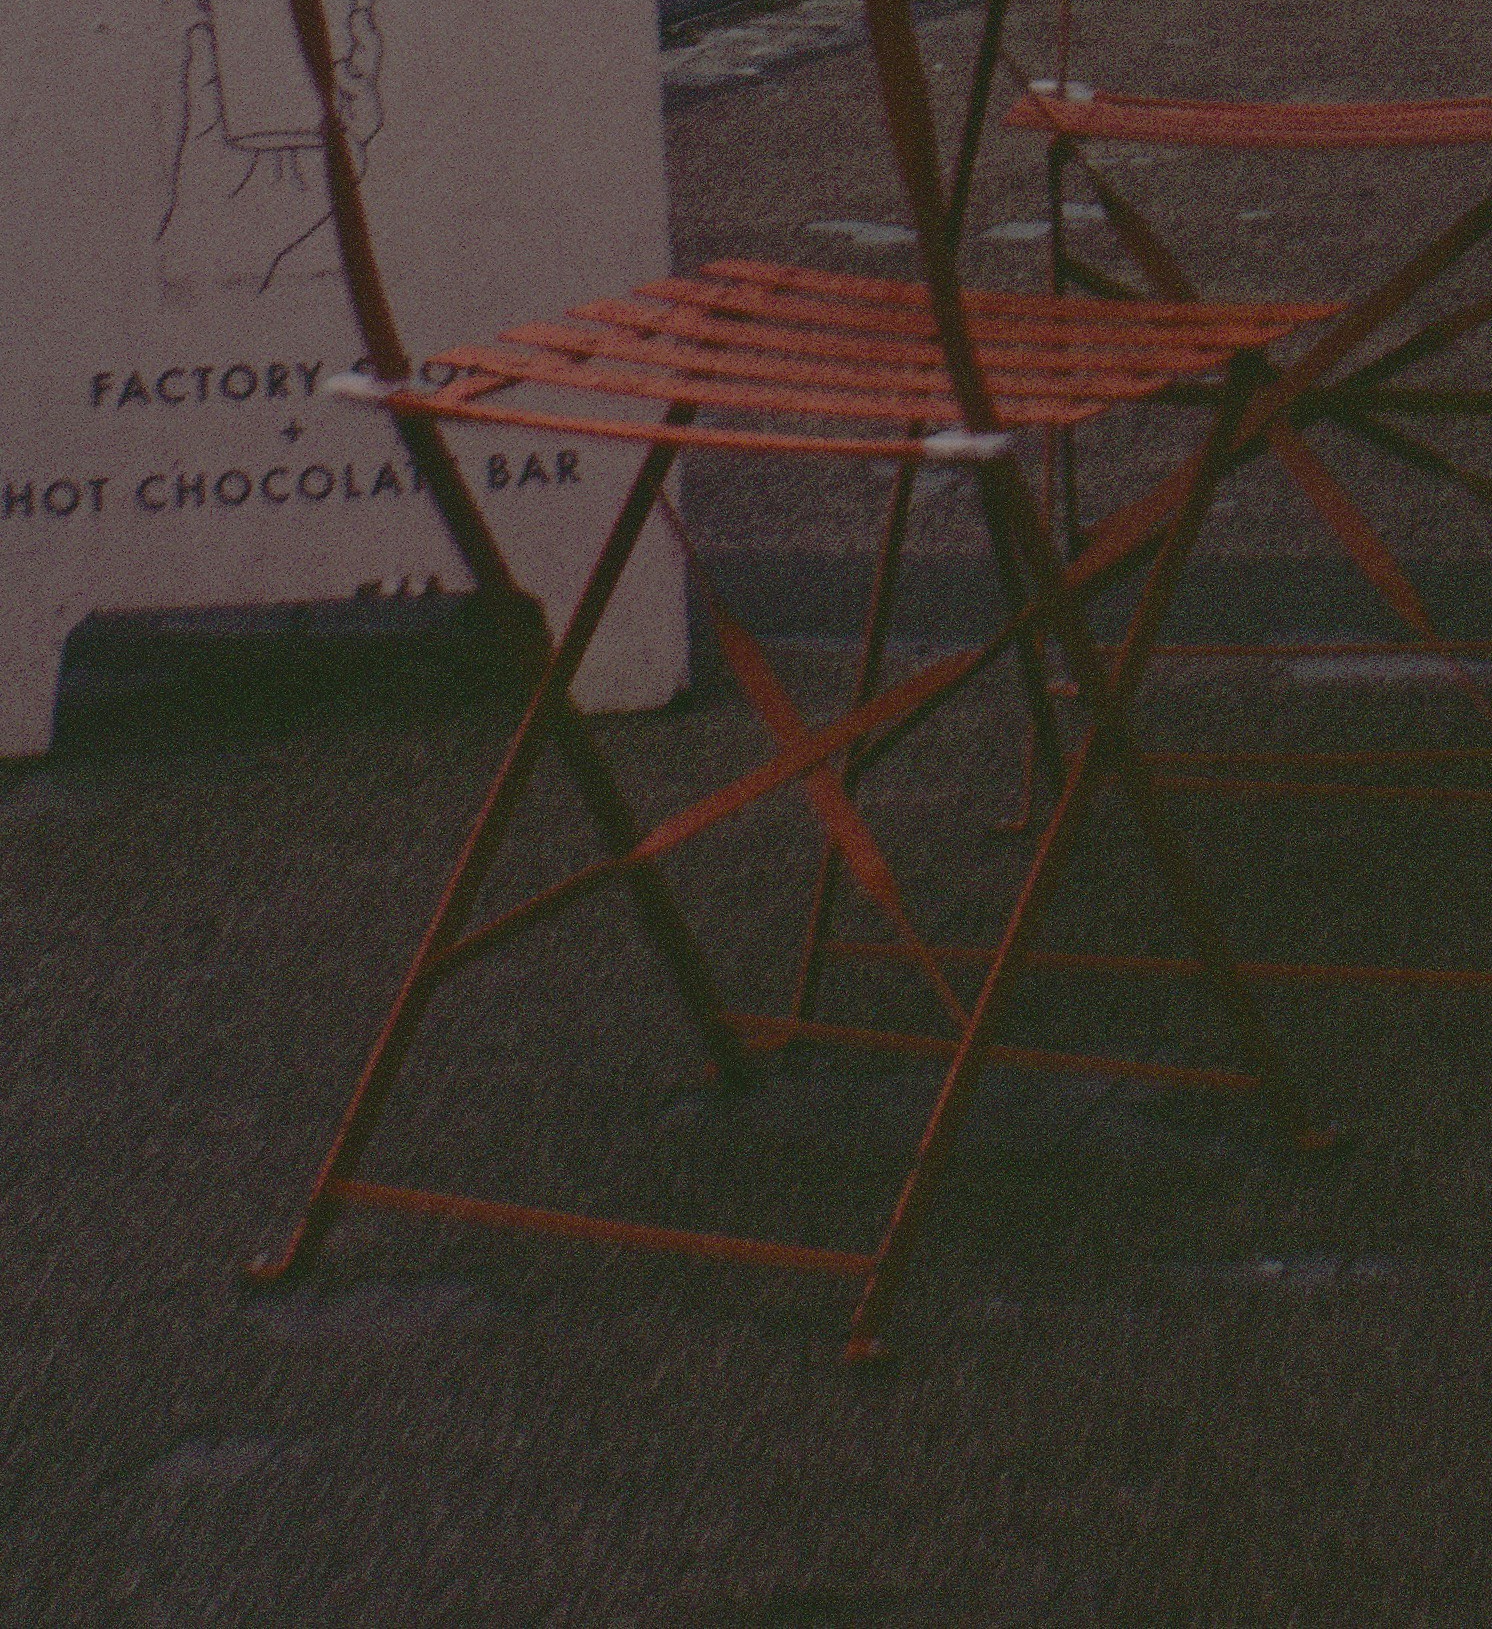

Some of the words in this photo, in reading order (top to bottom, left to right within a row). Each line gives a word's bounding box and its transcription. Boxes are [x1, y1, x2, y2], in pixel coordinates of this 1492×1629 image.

[91, 361, 322, 408] FACTORY
[2, 478, 109, 517] HOT
[136, 459, 440, 512] CHOCOLAT
[486, 451, 582, 491] BAR
